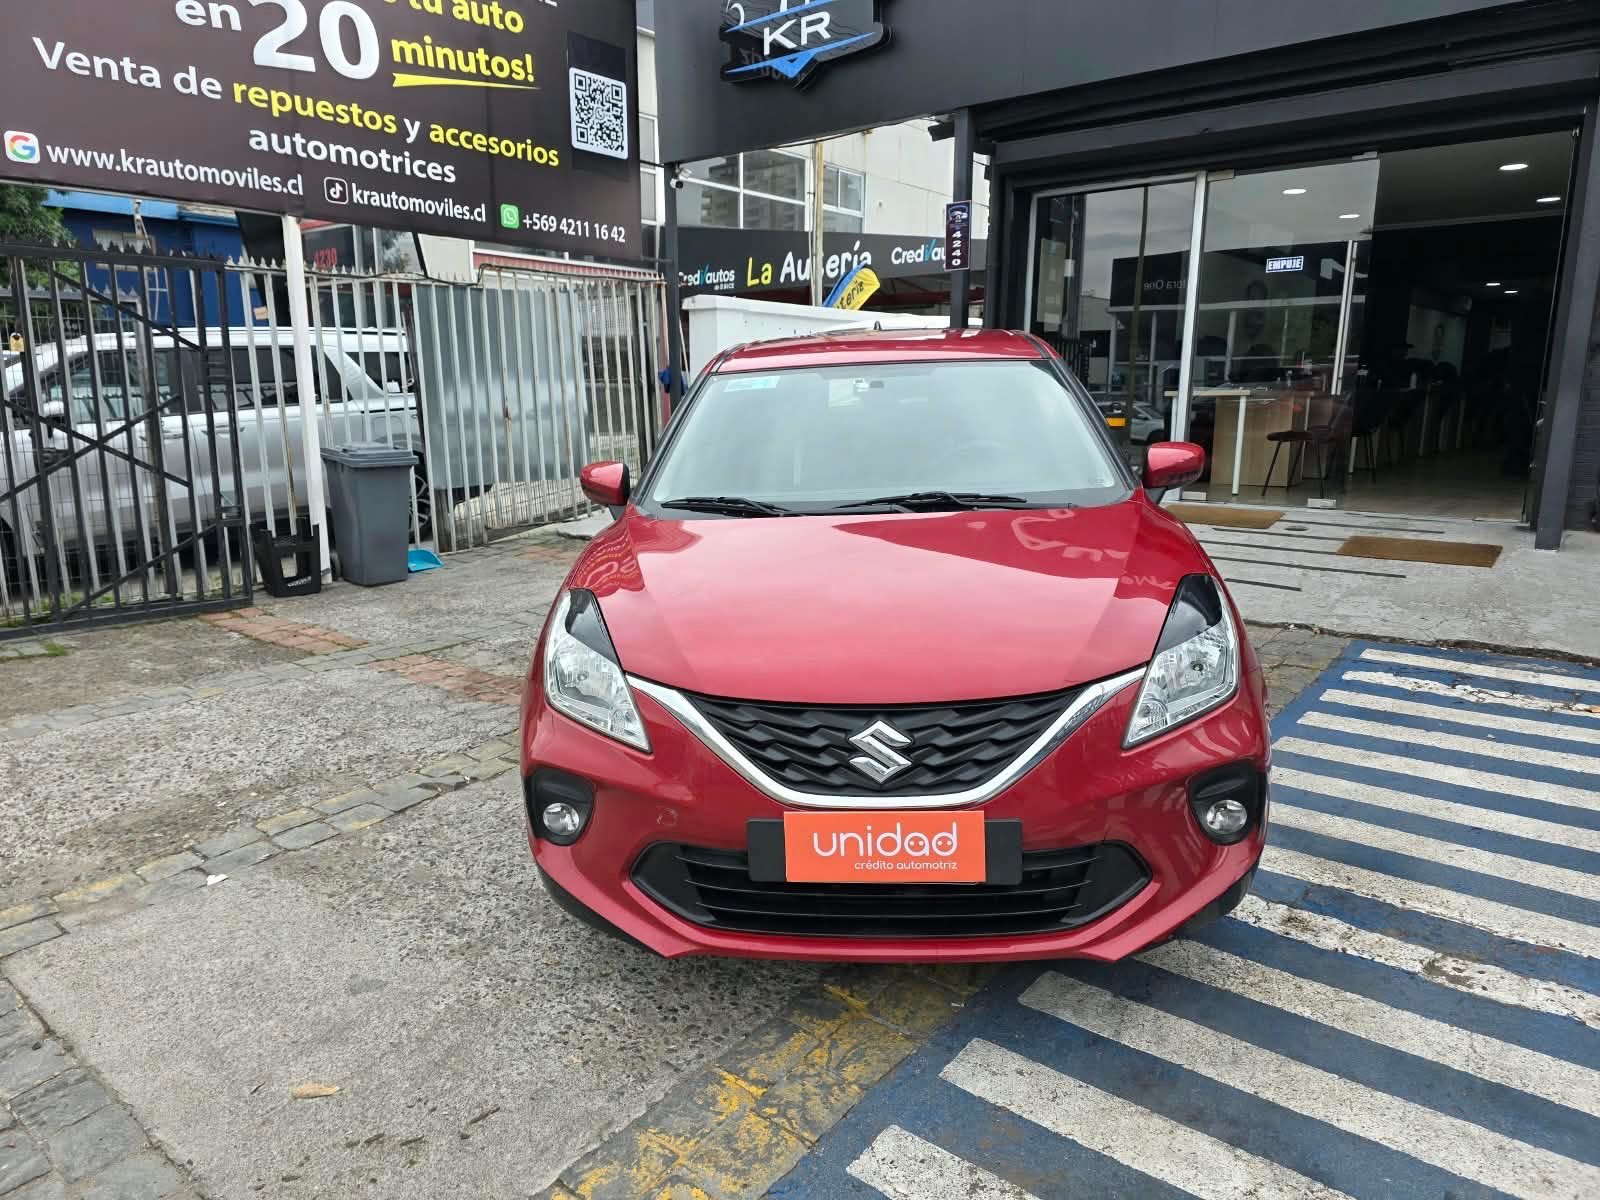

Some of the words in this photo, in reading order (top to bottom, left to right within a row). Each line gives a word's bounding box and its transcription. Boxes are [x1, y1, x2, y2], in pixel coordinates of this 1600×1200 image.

[451, 0, 524, 33] auto
[763, 11, 831, 56] KR
[175, 0, 242, 31] en
[247, 0, 380, 80] 20
[390, 35, 535, 82] minutos!
[32, 37, 162, 89] Venta
[173, 66, 222, 99] de
[233, 82, 397, 134] repuestos
[403, 118, 421, 143] y
[429, 123, 559, 167] accesorios
[46, 145, 304, 196] www.krautomoviles.cl
[249, 129, 456, 183] automotrices
[352, 183, 486, 222] krautomoviles.cl
[523, 213, 557, 233] +569
[560, 217, 590, 238] 4211
[747, 256, 773, 287] La
[780, 240, 872, 283] Auería
[951, 231, 963, 266] 4240
[1268, 258, 1302, 270] EMPUJE
[813, 821, 958, 857] unidad
[854, 859, 894, 871] crédito
[896, 860, 958, 871] automotriz
